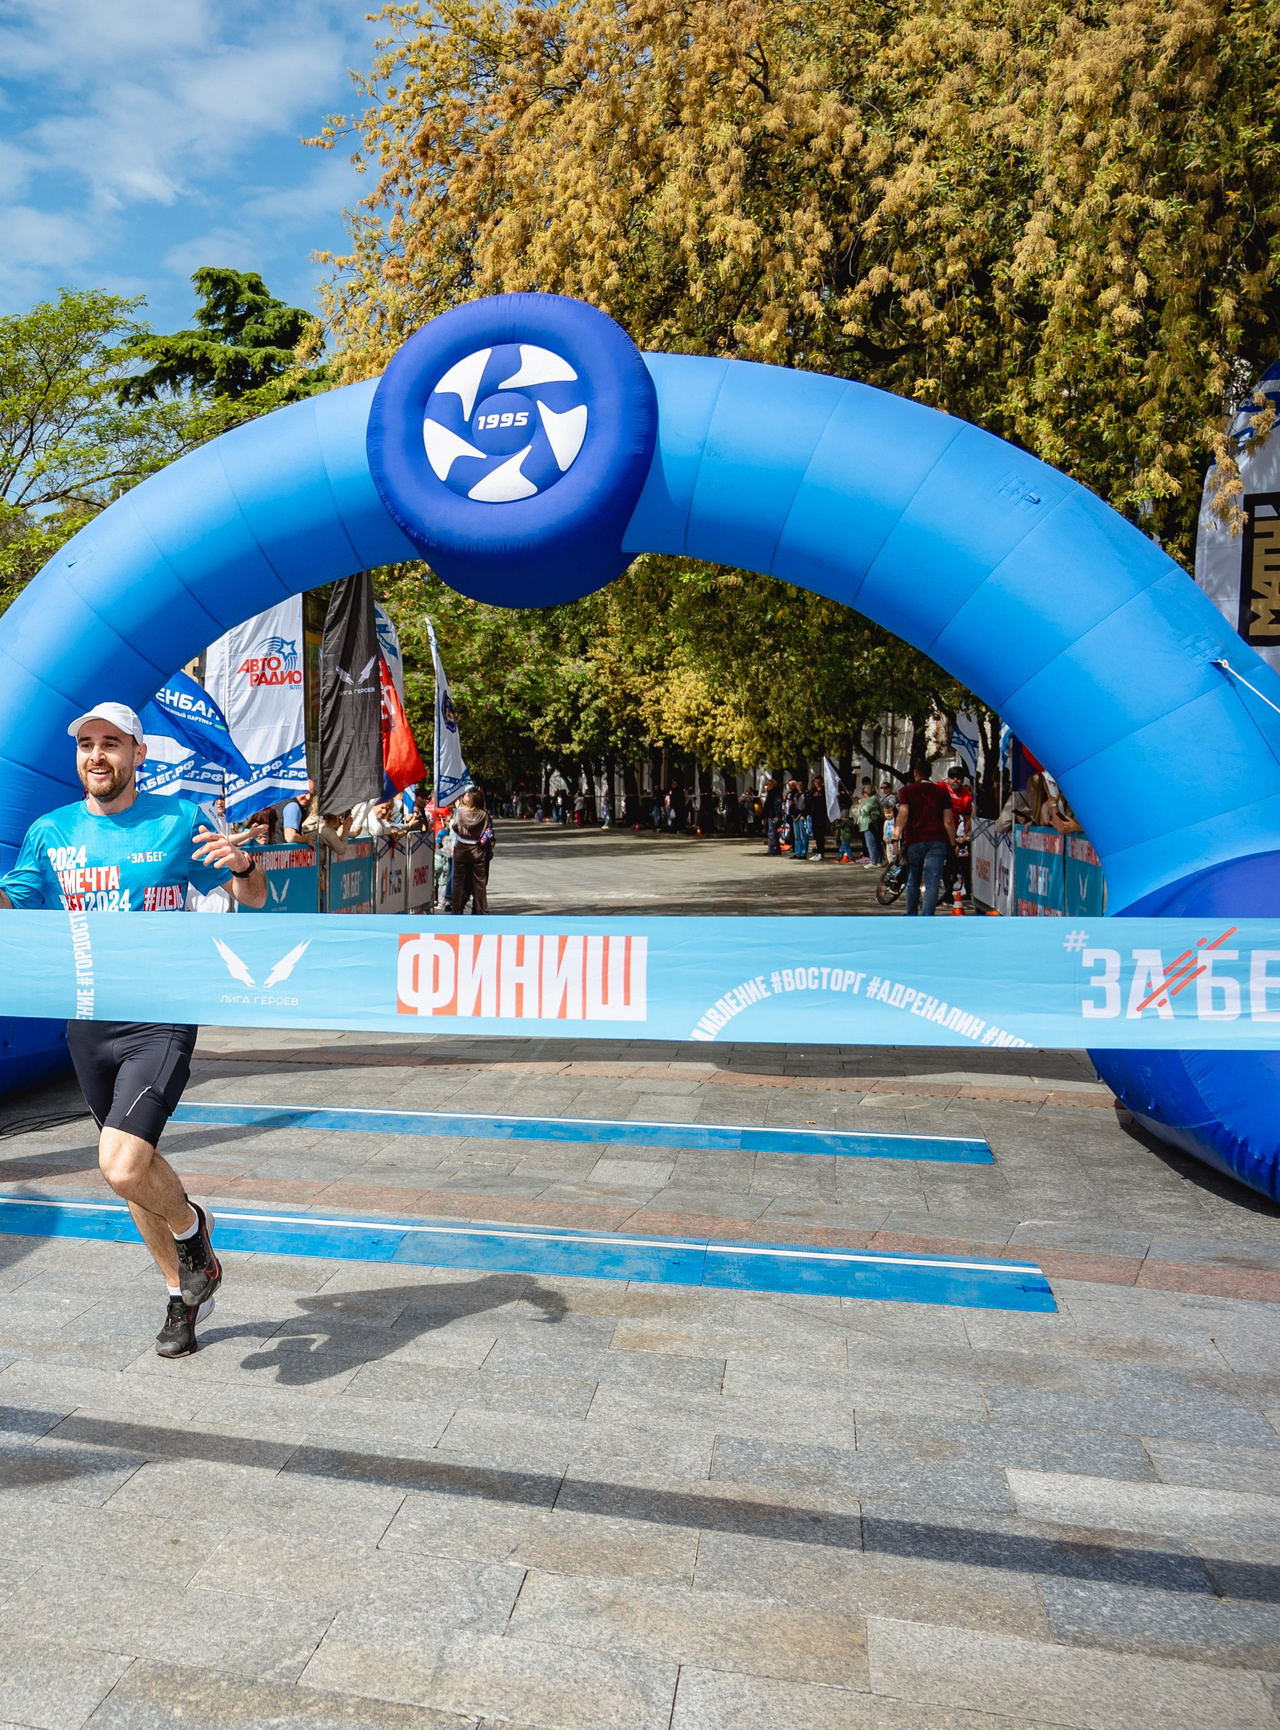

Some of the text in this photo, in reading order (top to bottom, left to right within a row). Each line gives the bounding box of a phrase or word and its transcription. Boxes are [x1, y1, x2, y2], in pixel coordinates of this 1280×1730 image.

[477, 411, 529, 430] 1995
[236, 657, 281, 674] АВТО
[250, 670, 302, 687] РАДИО
[47, 845, 87, 871] 2024
[57, 866, 120, 895] #МЕЧТА
[397, 933, 648, 1021] ФИНИШ
[220, 995, 299, 1006] ЛИГА ГЕРОЕВ
[689, 975, 771, 1041] ДИВЛЕНИЕ
[771, 967, 867, 995] #ВОСТОРГ
[866, 976, 986, 1040] #АДРЕНАЛИН
